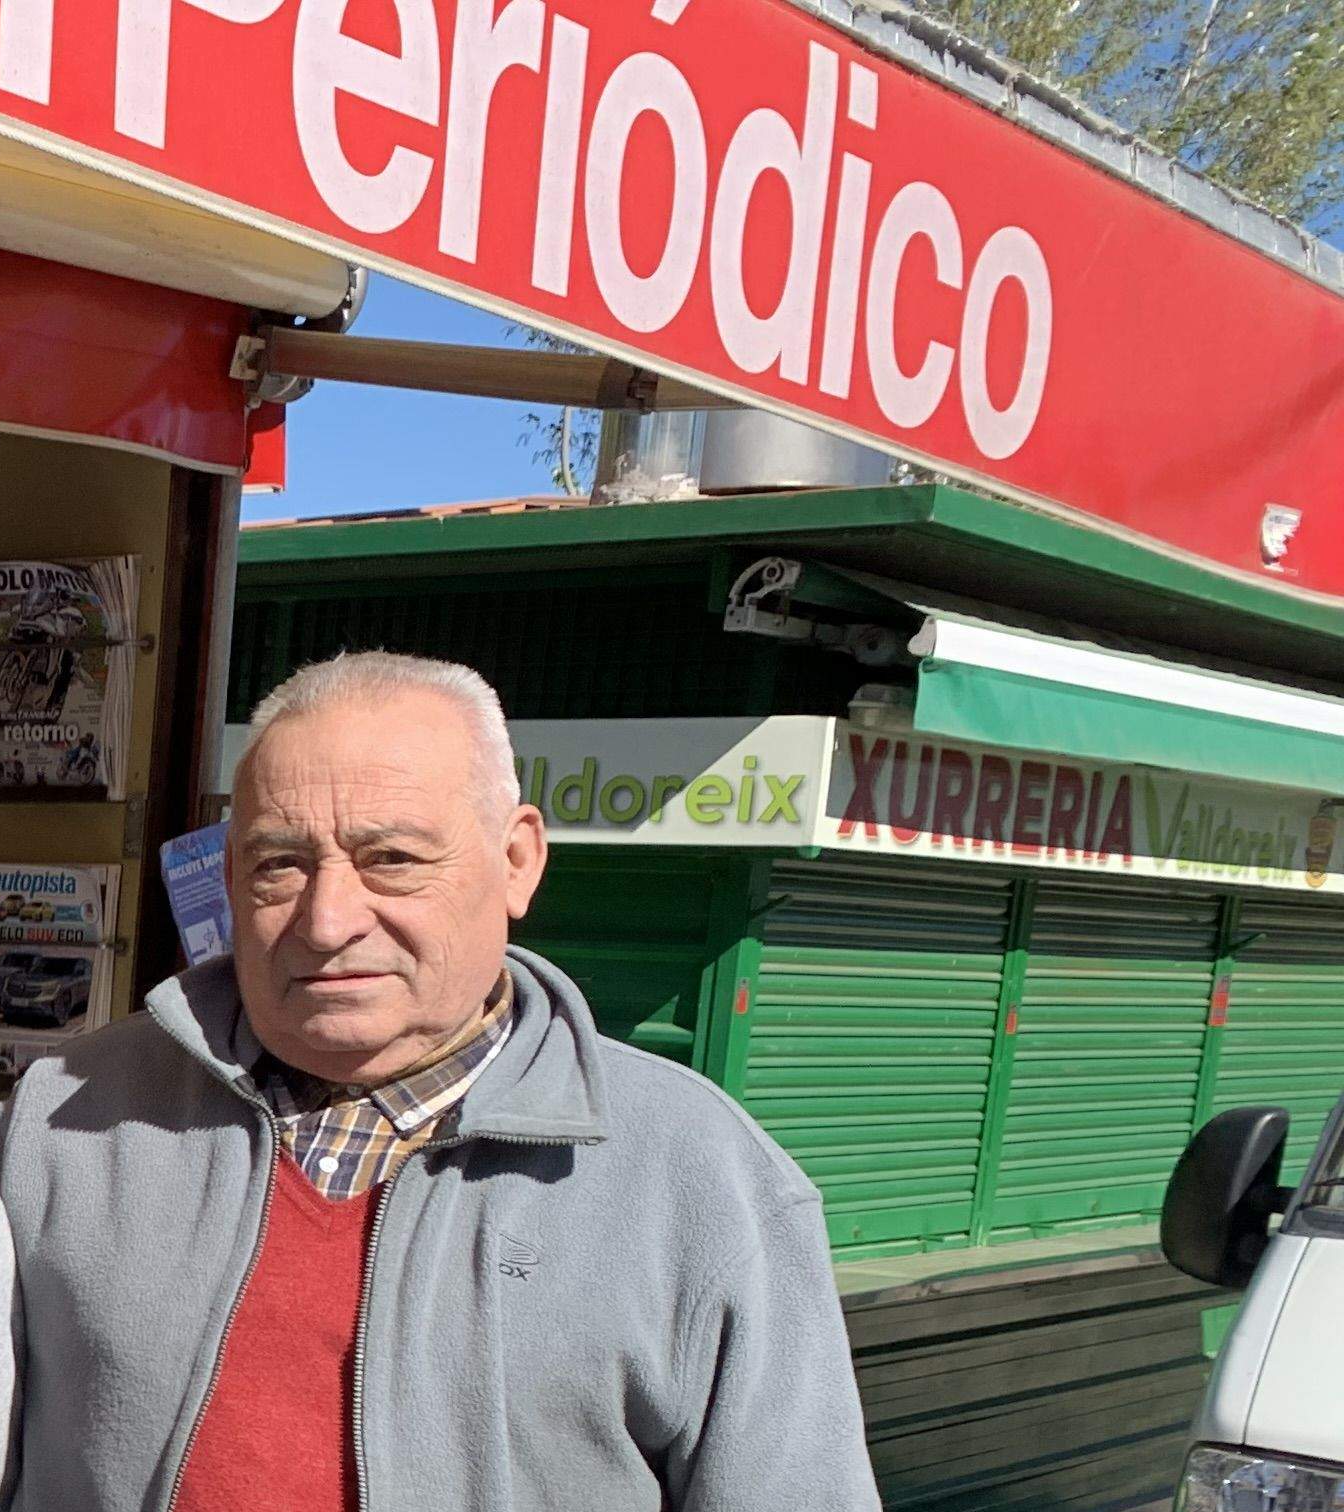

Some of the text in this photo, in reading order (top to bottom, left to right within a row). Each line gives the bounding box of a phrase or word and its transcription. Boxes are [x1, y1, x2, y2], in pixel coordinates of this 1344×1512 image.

[3, 721, 79, 742] retorno
[515, 754, 807, 825] ldoreix
[837, 732, 1298, 883] XURRERIA Valldoreix
[27, 927, 54, 942] SUV
[57, 929, 84, 942] ECO
